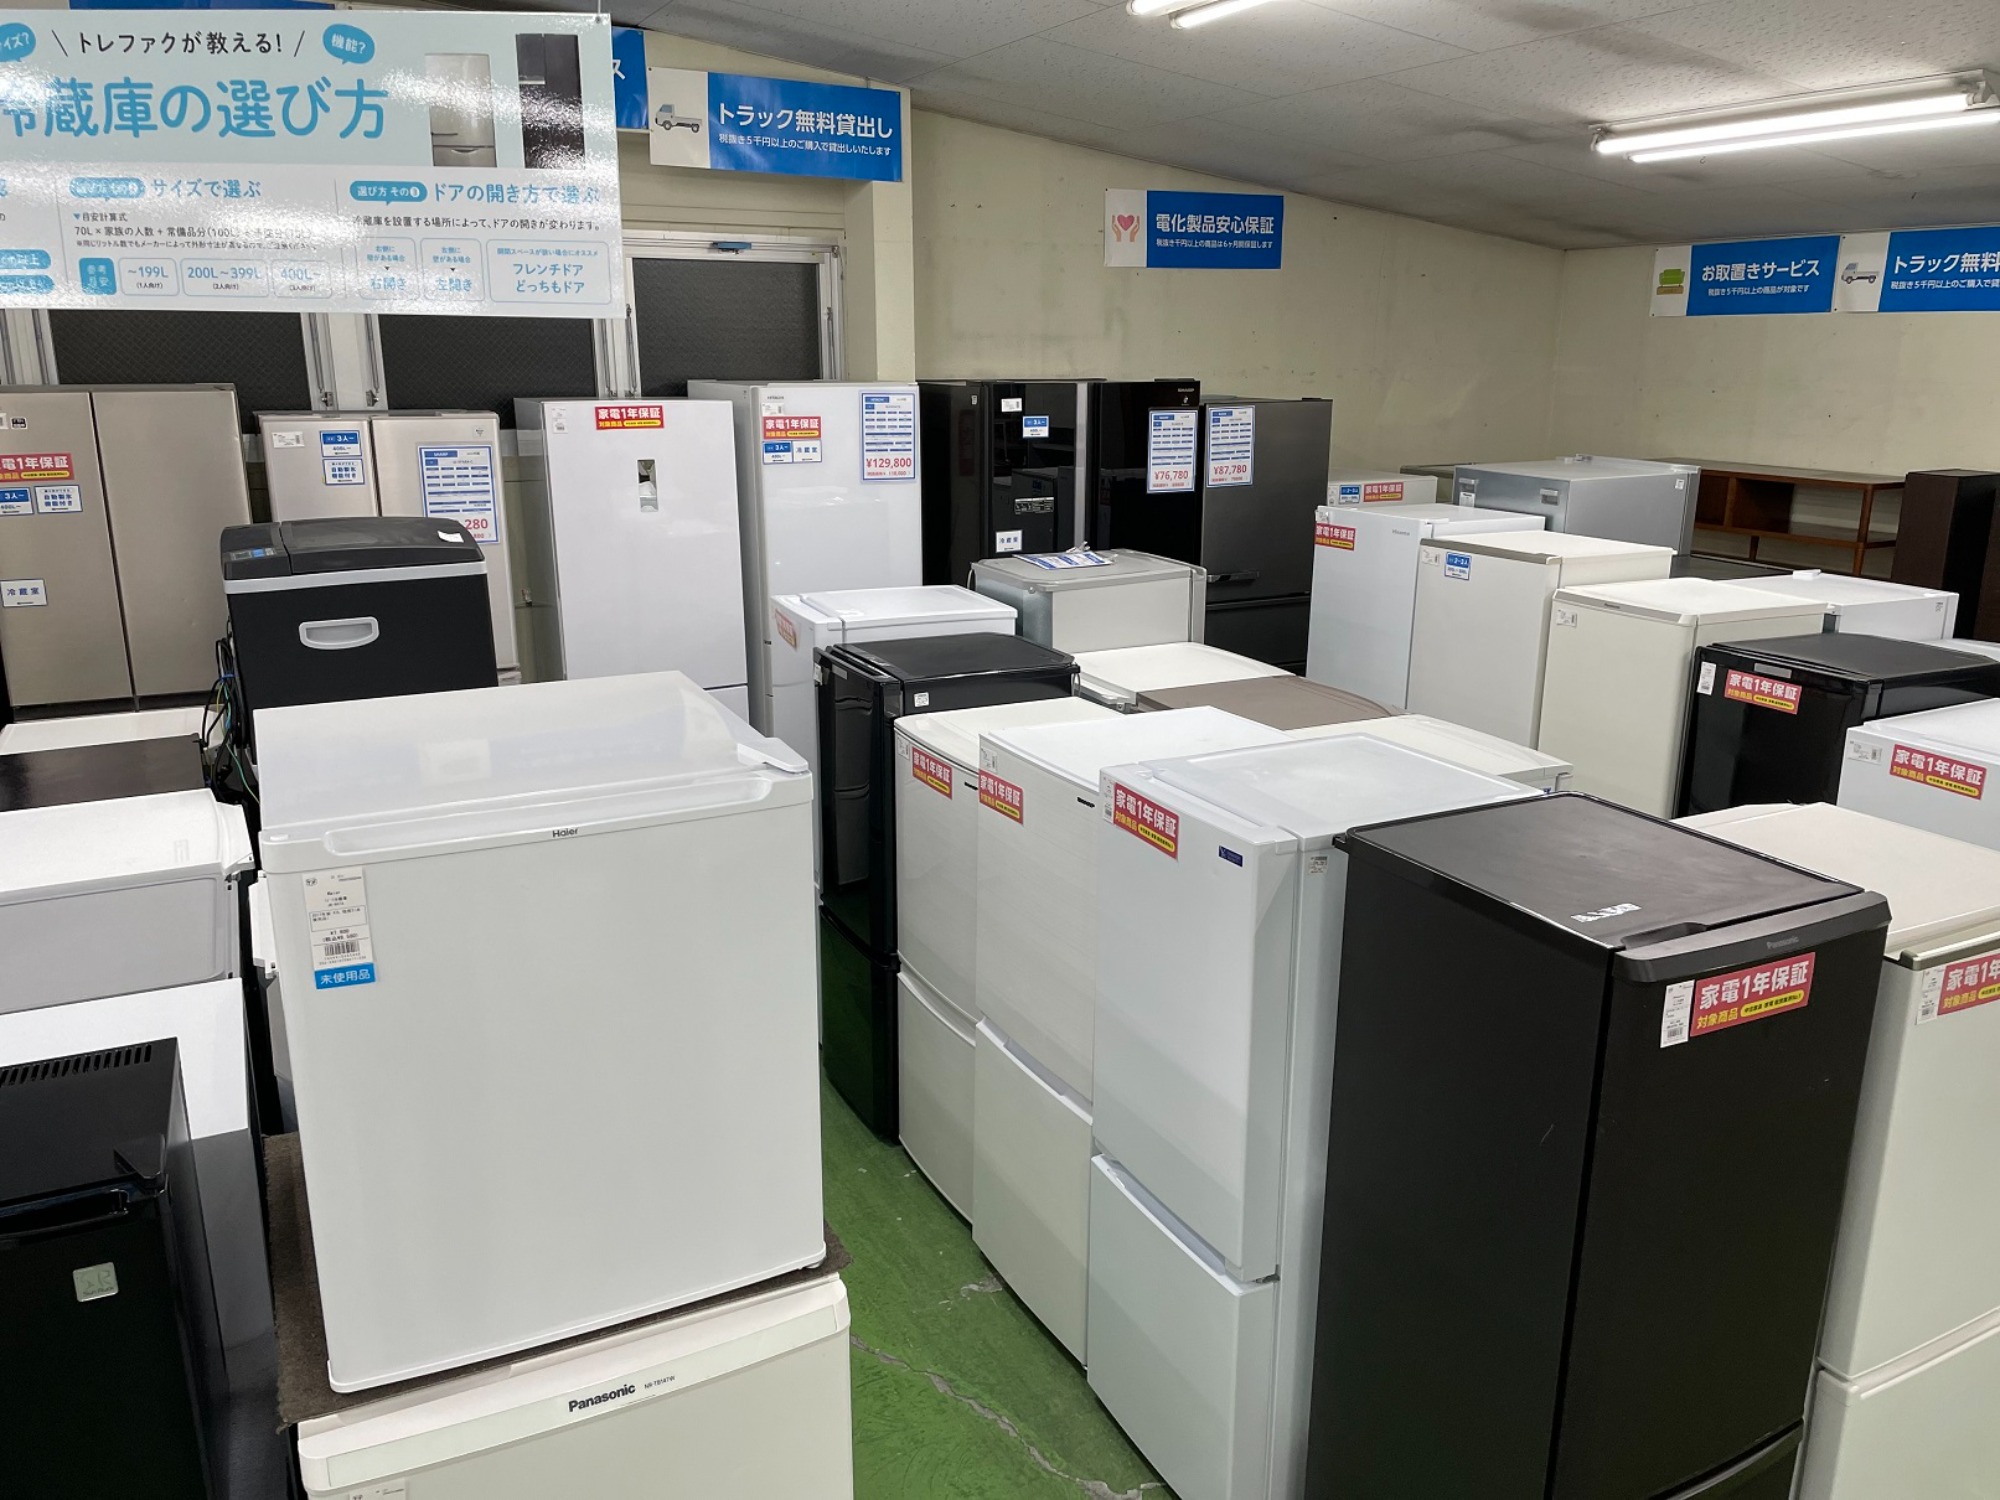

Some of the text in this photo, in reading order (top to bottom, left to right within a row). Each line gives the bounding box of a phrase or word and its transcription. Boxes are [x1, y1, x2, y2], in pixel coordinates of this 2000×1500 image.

[0, 32, 30, 50] イズ?
[79, 31, 282, 55] トレファクが教える!
[331, 33, 366, 54] 機能?
[719, 103, 893, 139] トラック無料貸出し
[153, 178, 261, 199] サイズで選ぶ
[357, 187, 387, 197] 選び方
[434, 182, 600, 204] ドアの開き方で選ぶ
[82, 212, 128, 222] 目安計算式
[1156, 213, 1275, 235] 電化製品安心保証
[74, 226, 93, 236] 70L
[104, 226, 154, 237] 家族の人数
[513, 263, 584, 277] フレンチドア
[1701, 259, 1820, 282] お取置きサービス
[1894, 251, 2000, 274] トラック無料
[516, 280, 585, 294] どっちもドア
[598, 407, 661, 420] 家電1年保証
[765, 417, 819, 430] 家電1年保証
[0, 455, 69, 471] 電1年保証
[866, 457, 912, 469] ¥129,800
[1213, 464, 1247, 475] ¥87,780
[1154, 470, 1189, 481] ¥76,780
[464, 517, 489, 531] 280
[1316, 525, 1355, 541] 家電1年保証
[1729, 673, 1798, 701] 家電1年保証
[913, 751, 951, 784] 家電1年保証
[1894, 749, 1983, 786] 家電1年保証
[980, 775, 1020, 807] 家電1年保証
[1115, 788, 1177, 839] 家電1年保証
[552, 828, 579, 838] Haier
[320, 968, 371, 985] 未使用品
[1700, 960, 1810, 1010] 家電1年保証
[1696, 1007, 1738, 1030] 対象商品
[568, 1384, 636, 1412] Panasonic
